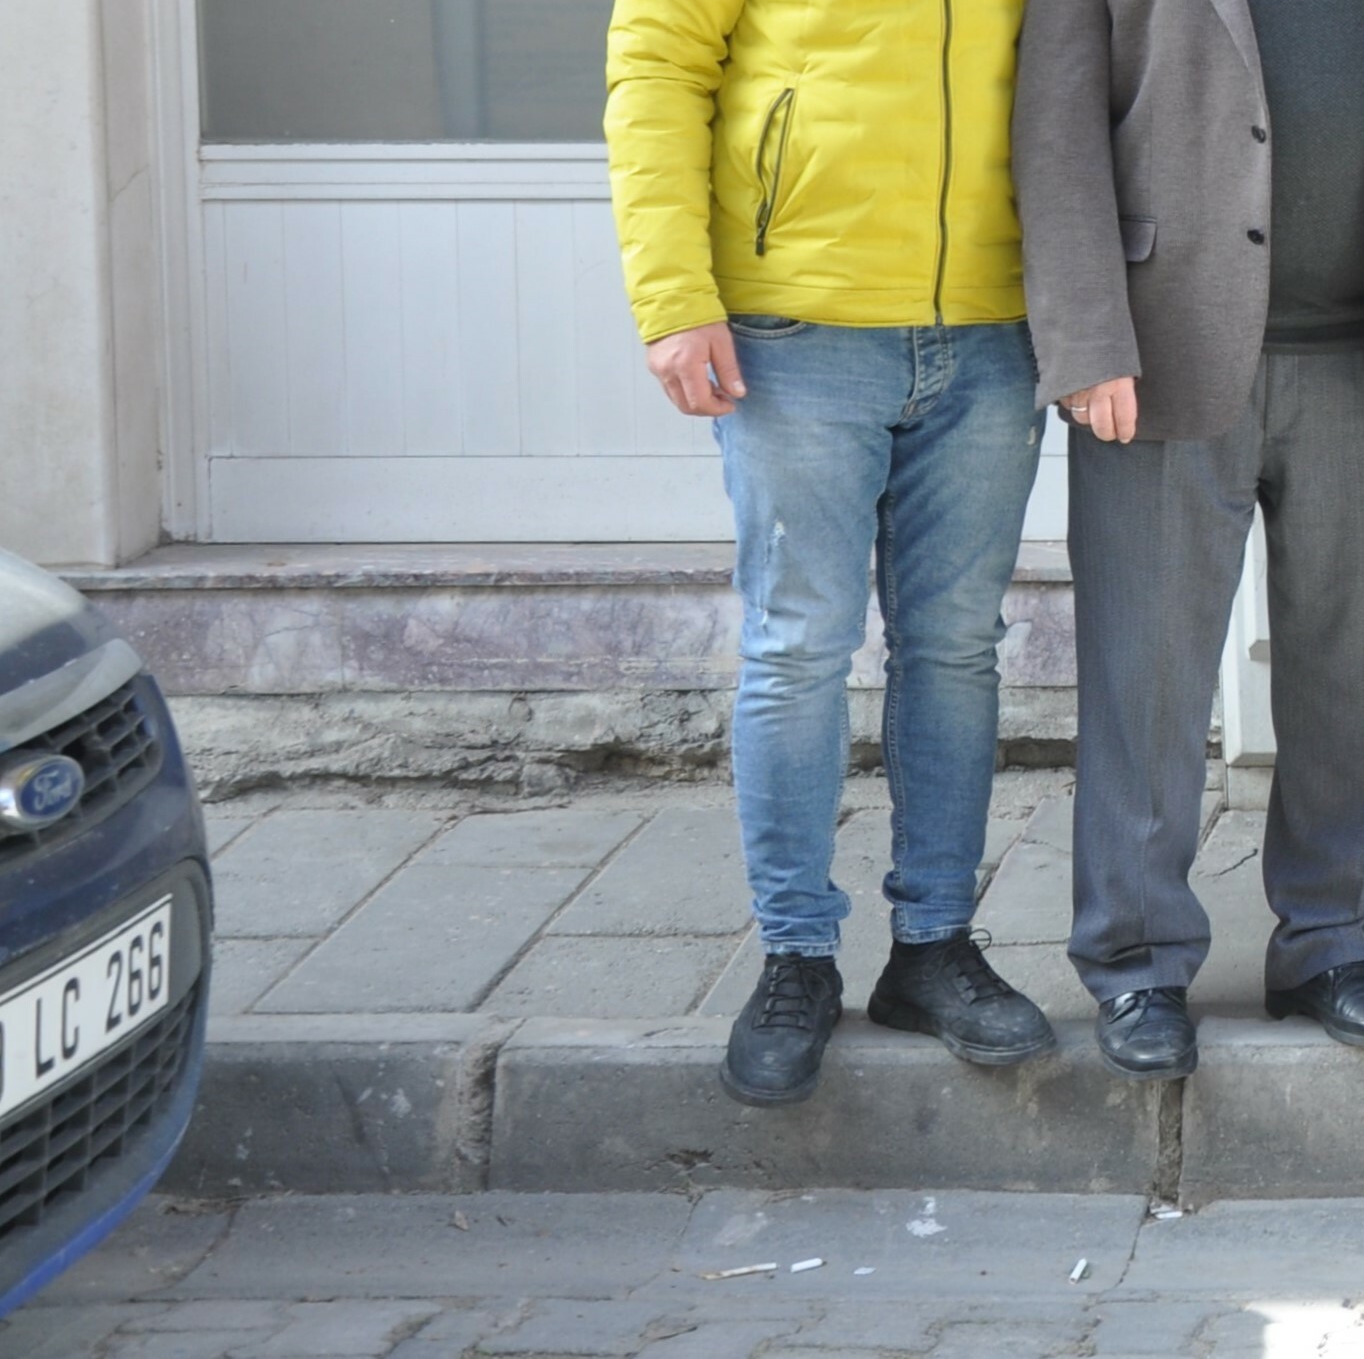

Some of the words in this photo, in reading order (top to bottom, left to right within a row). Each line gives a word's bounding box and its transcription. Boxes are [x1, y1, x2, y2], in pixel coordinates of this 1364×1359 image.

[33, 771, 74, 812] Ford
[35, 976, 81, 1080] LC
[106, 920, 164, 1034] 266
